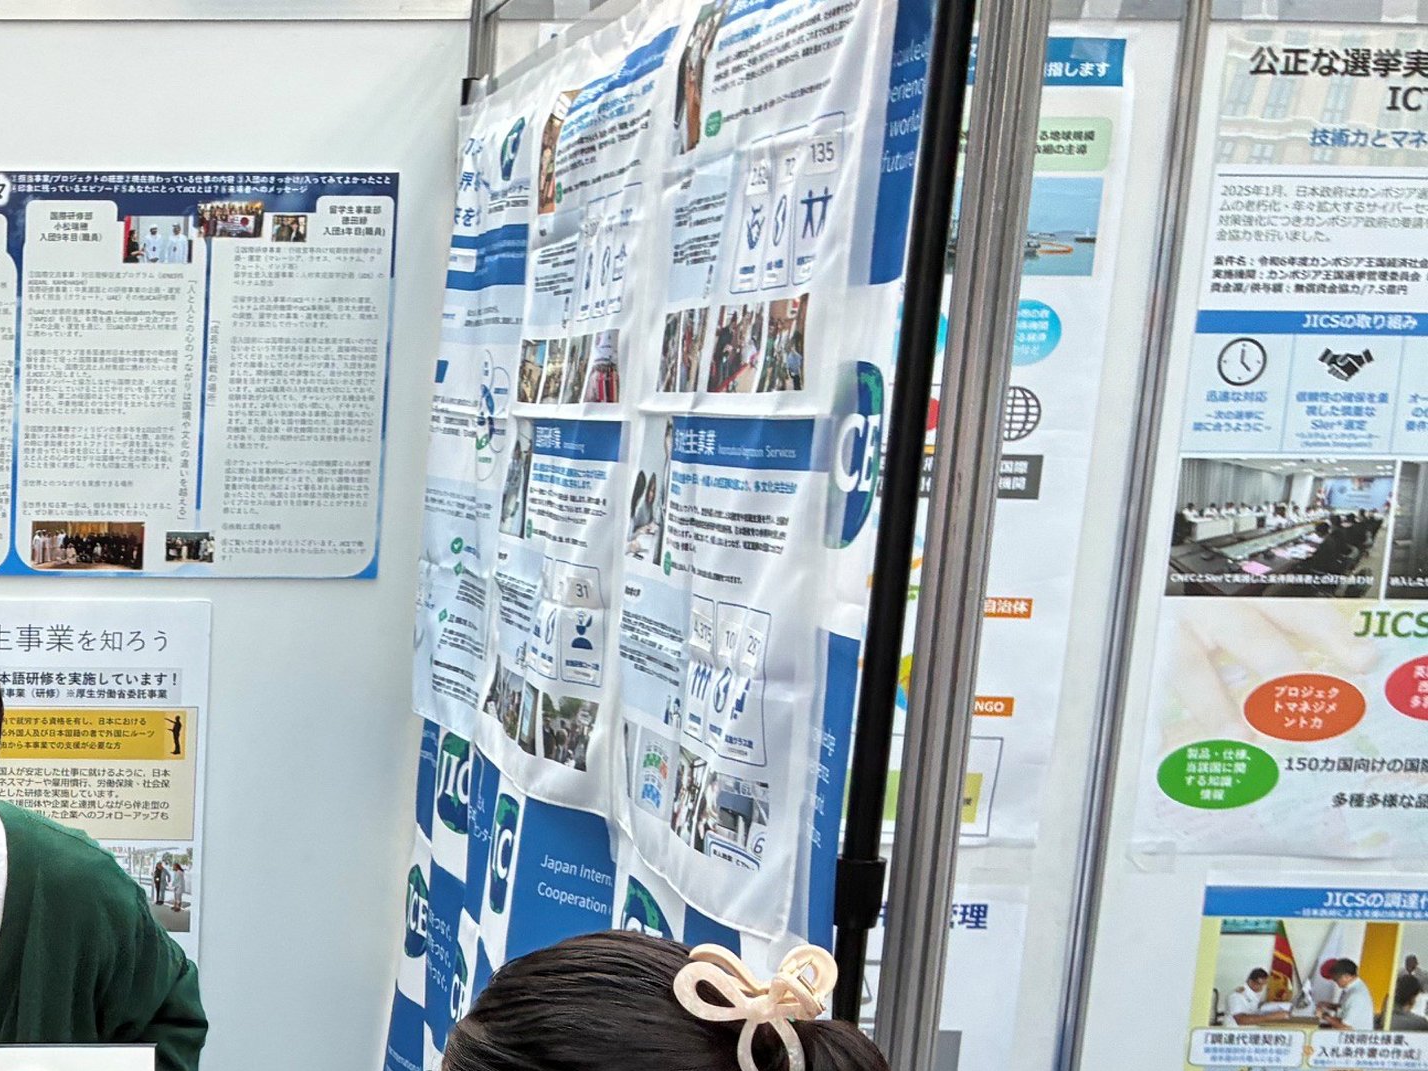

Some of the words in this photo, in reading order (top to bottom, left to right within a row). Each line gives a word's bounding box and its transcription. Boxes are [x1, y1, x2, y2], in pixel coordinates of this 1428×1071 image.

[810, 141, 835, 163] 135
[1302, 314, 1418, 330] JICSの取り組み
[575, 583, 589, 599] 31
[974, 700, 1005, 714] NGO
[540, 854, 578, 876] Japan
[579, 858, 613, 887] Intern
[537, 881, 608, 915] Cooperation
